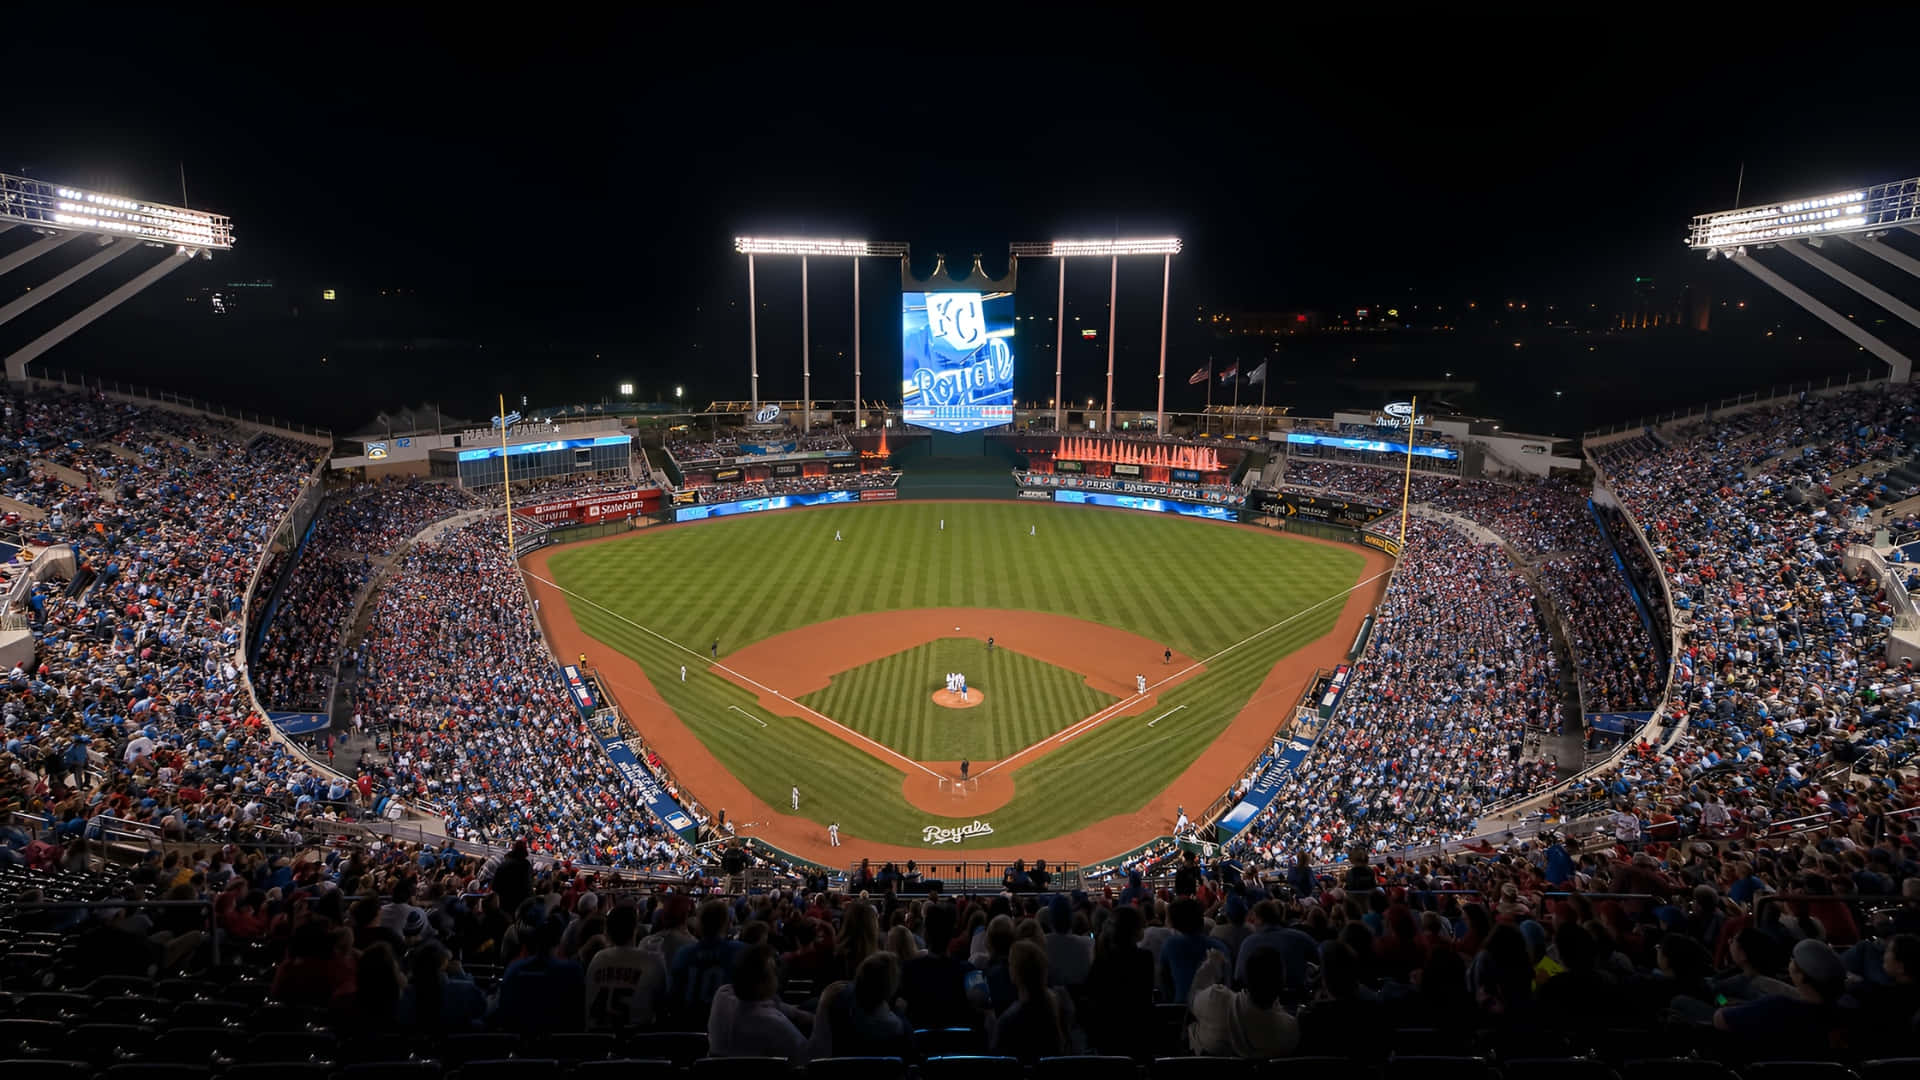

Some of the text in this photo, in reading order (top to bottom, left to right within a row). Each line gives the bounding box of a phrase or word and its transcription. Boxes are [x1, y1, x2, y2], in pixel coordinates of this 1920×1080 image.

[936, 298, 977, 344] KC
[1376, 415, 1425, 429] Party Dck
[396, 438, 411, 448] 42
[1086, 480, 1115, 490] PEPSI
[1124, 483, 1157, 495] PARTY
[1261, 502, 1287, 515] Sprint
[922, 820, 994, 846] Royals
